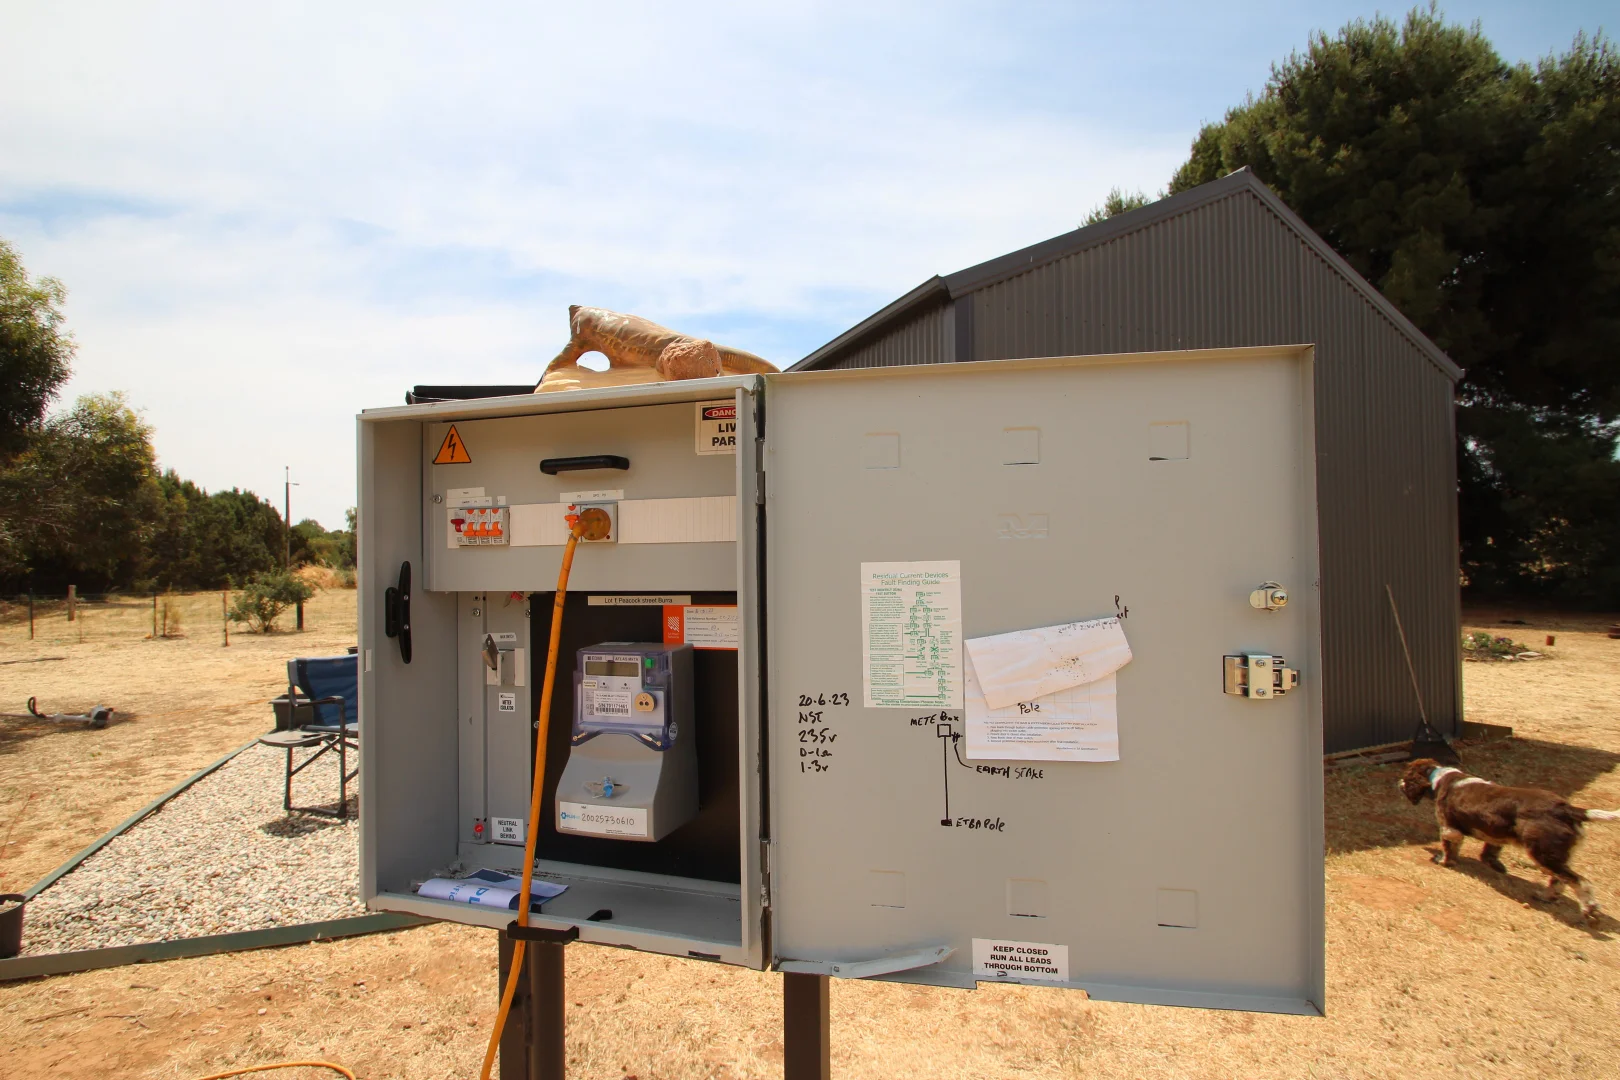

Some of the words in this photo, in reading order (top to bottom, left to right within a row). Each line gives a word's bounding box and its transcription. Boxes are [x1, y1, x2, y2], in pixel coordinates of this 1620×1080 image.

[940, 711, 959, 721] Box
[976, 765, 1010, 778] EARTH
[1015, 768, 1043, 779] STAKE
[984, 817, 1005, 832] Pole
[1025, 966, 1058, 974] BOTTOM
